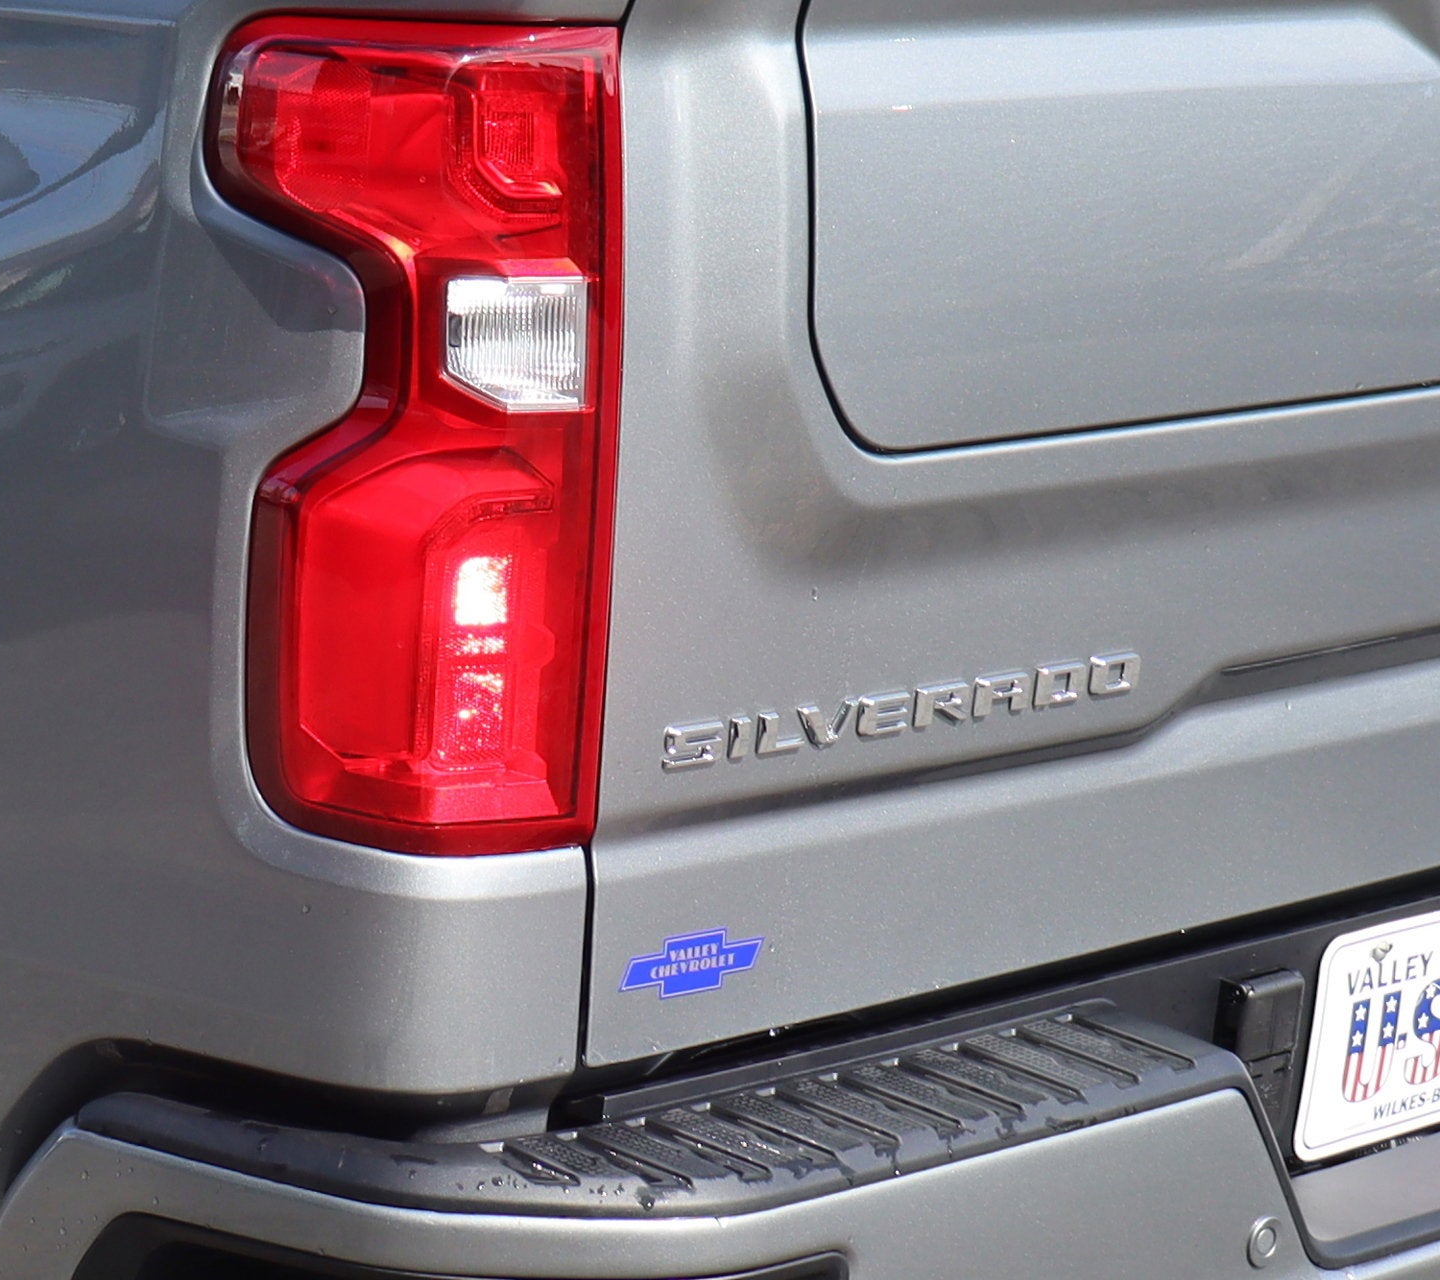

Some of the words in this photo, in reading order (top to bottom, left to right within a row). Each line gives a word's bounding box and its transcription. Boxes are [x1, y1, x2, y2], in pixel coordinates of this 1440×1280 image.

[662, 651, 1141, 770] SILVERADO
[650, 953, 736, 979] CHEVROLET
[669, 943, 719, 962] VALLEY
[1347, 950, 1437, 997] VALLEY
